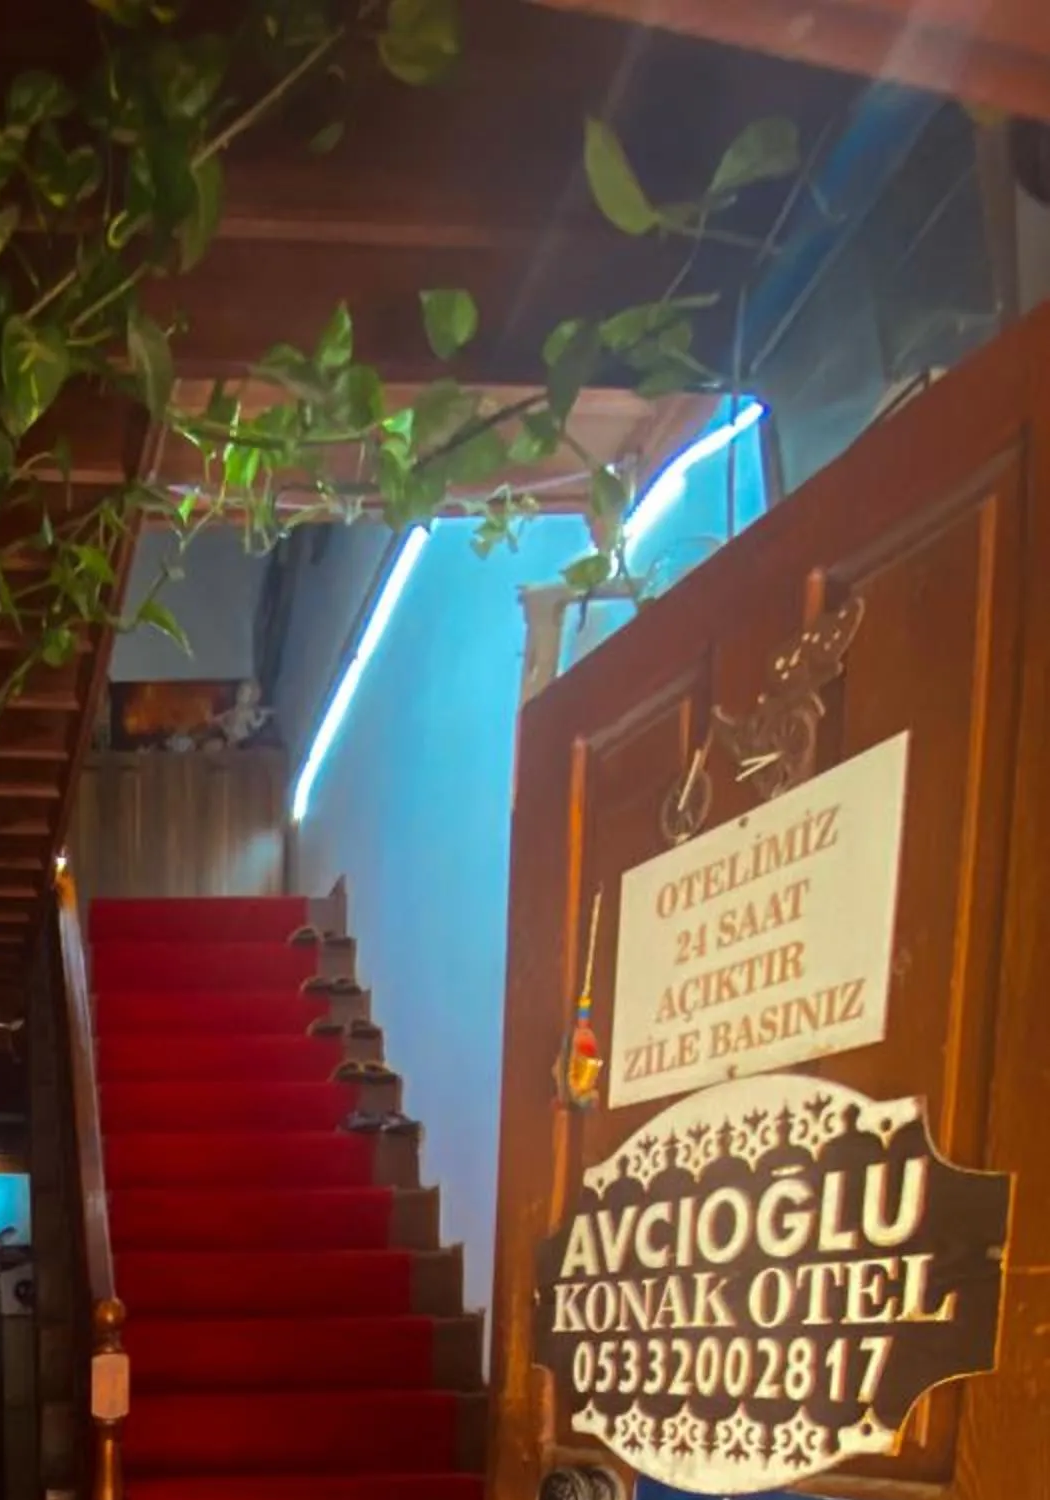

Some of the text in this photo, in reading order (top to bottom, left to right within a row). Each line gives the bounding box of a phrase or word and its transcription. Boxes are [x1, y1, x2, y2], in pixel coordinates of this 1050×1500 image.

[656, 803, 842, 919] OTELİMİZ
[673, 878, 810, 966] 24 SAAT
[655, 940, 806, 1025] AÇIKTIR
[622, 978, 867, 1083] ZİLE BASINIZ
[560, 1156, 929, 1278] AVCIOĞLU
[551, 1254, 957, 1334] KONAK OTEL
[572, 1335, 893, 1404] 05332002817
